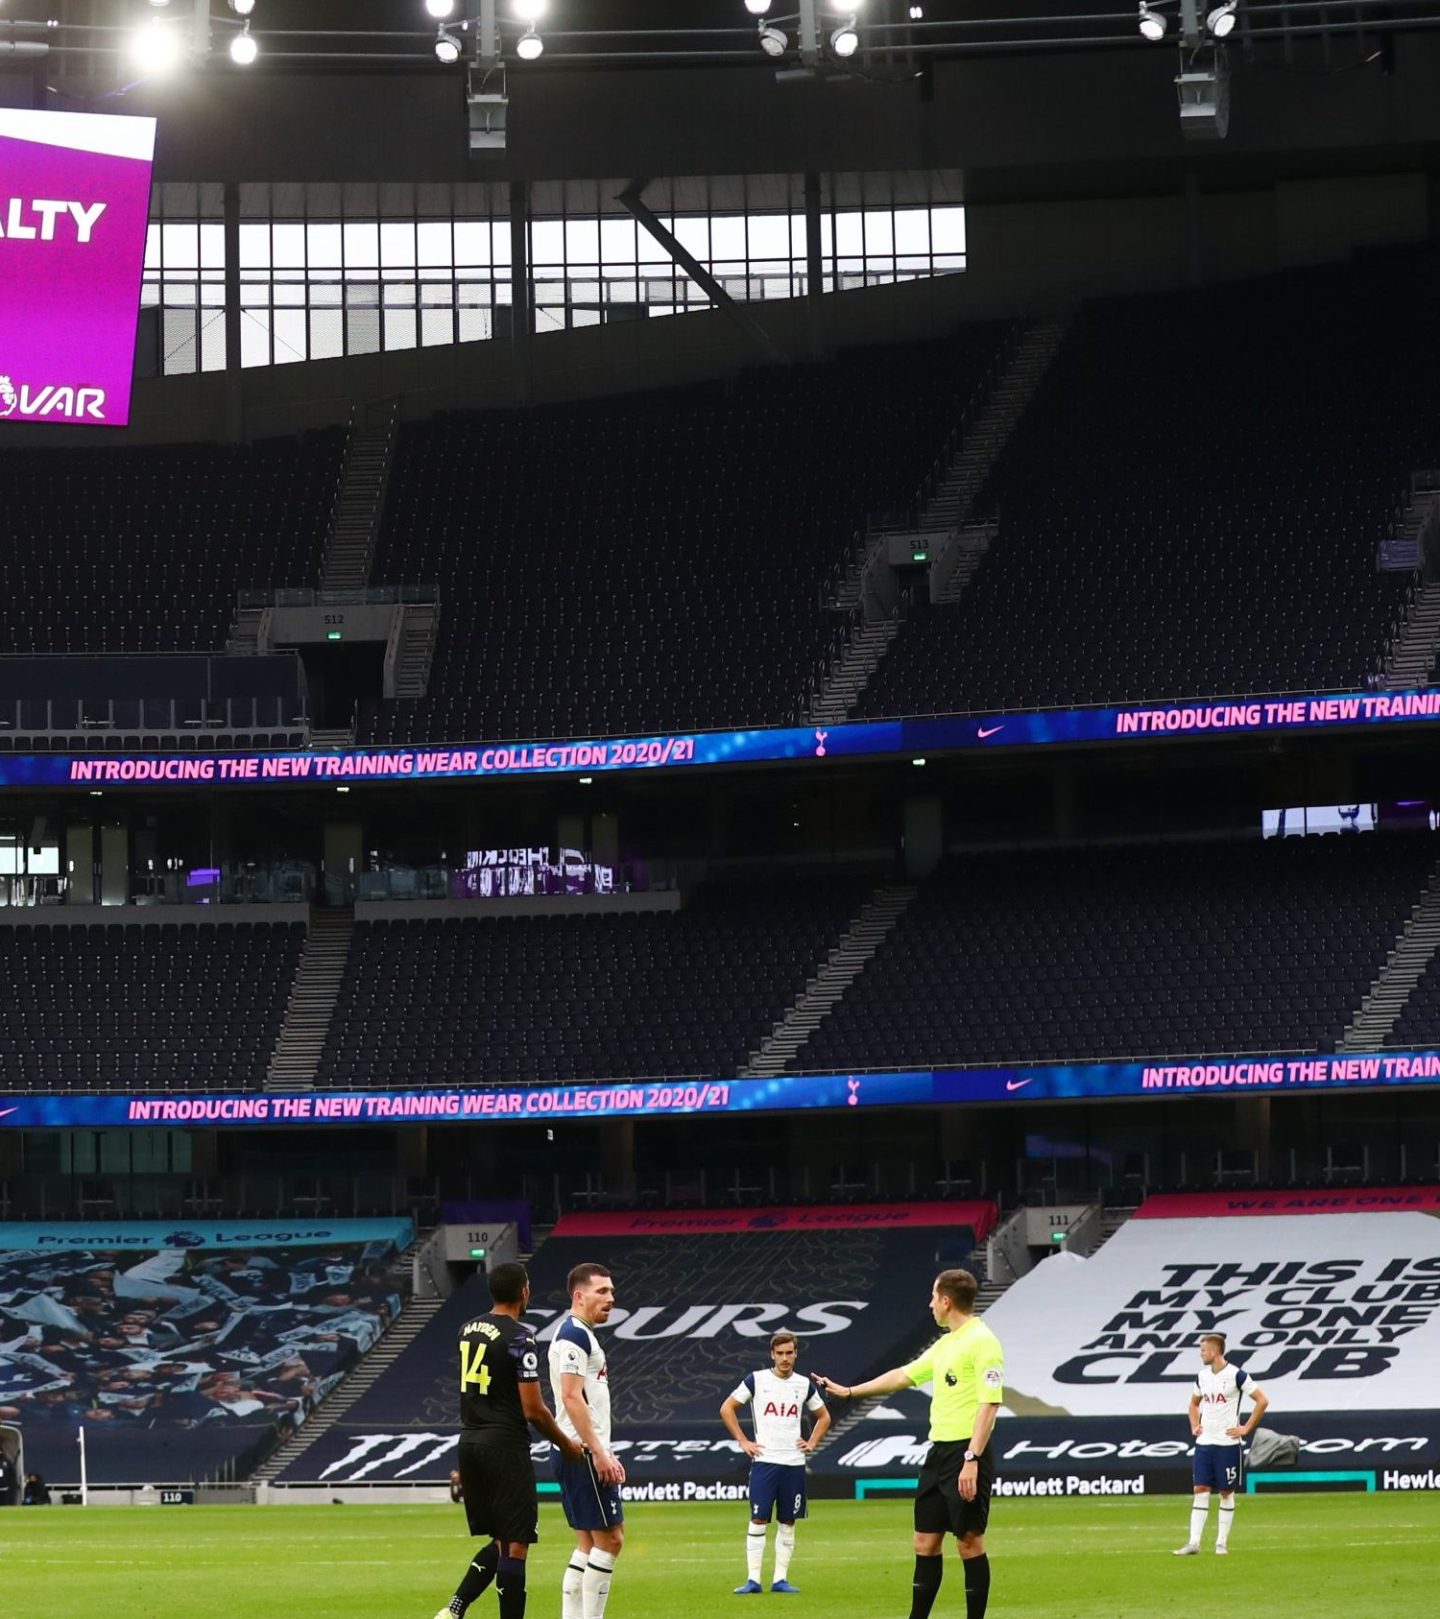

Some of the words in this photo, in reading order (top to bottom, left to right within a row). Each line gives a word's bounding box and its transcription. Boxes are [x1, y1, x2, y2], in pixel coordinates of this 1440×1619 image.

[20, 384, 106, 418] VAR
[323, 615, 343, 624] 512
[1118, 706, 1260, 731] INTRODUCING
[1265, 703, 1305, 722] THE
[1310, 700, 1359, 720] NEW
[72, 760, 213, 778] INTRODUCING
[219, 760, 258, 777] THE
[263, 758, 311, 776] NEW
[314, 755, 412, 774] TRAINING
[418, 752, 477, 771] WEAR
[482, 747, 606, 769] COLLECTION
[611, 739, 693, 763] 2020/21
[1143, 1064, 1283, 1086] INTRODUCING
[1288, 1062, 1327, 1081] THE
[1332, 1060, 1380, 1079] NEW
[130, 1100, 267, 1118] INTRODUCING
[272, 1100, 311, 1116] THE
[315, 1099, 362, 1116] NEW
[366, 1096, 459, 1115] TRAINING
[464, 1095, 521, 1113] WEAR
[527, 1091, 643, 1111] COLLECTION
[647, 1085, 728, 1108] 2020/21
[1049, 1215, 1068, 1225] 111
[37, 1236, 154, 1245] Premier
[215, 1230, 332, 1243] League
[467, 1232, 488, 1243] 110
[1162, 1260, 1364, 1287] THIS
[1125, 1286, 1250, 1308] MY
[1264, 1283, 1440, 1306] CLUB
[1102, 1310, 1246, 1331] MY
[1261, 1302, 1439, 1329] ONE
[1241, 1326, 1415, 1346] ONLY
[460, 1341, 492, 1395] 14
[763, 1401, 799, 1418] AIA
[1225, 1467, 1237, 1479] 15
[617, 1481, 681, 1502] ewlett
[1066, 1475, 1145, 1496] Packard
[163, 1492, 182, 1503] 110
[794, 1493, 802, 1509] 8
